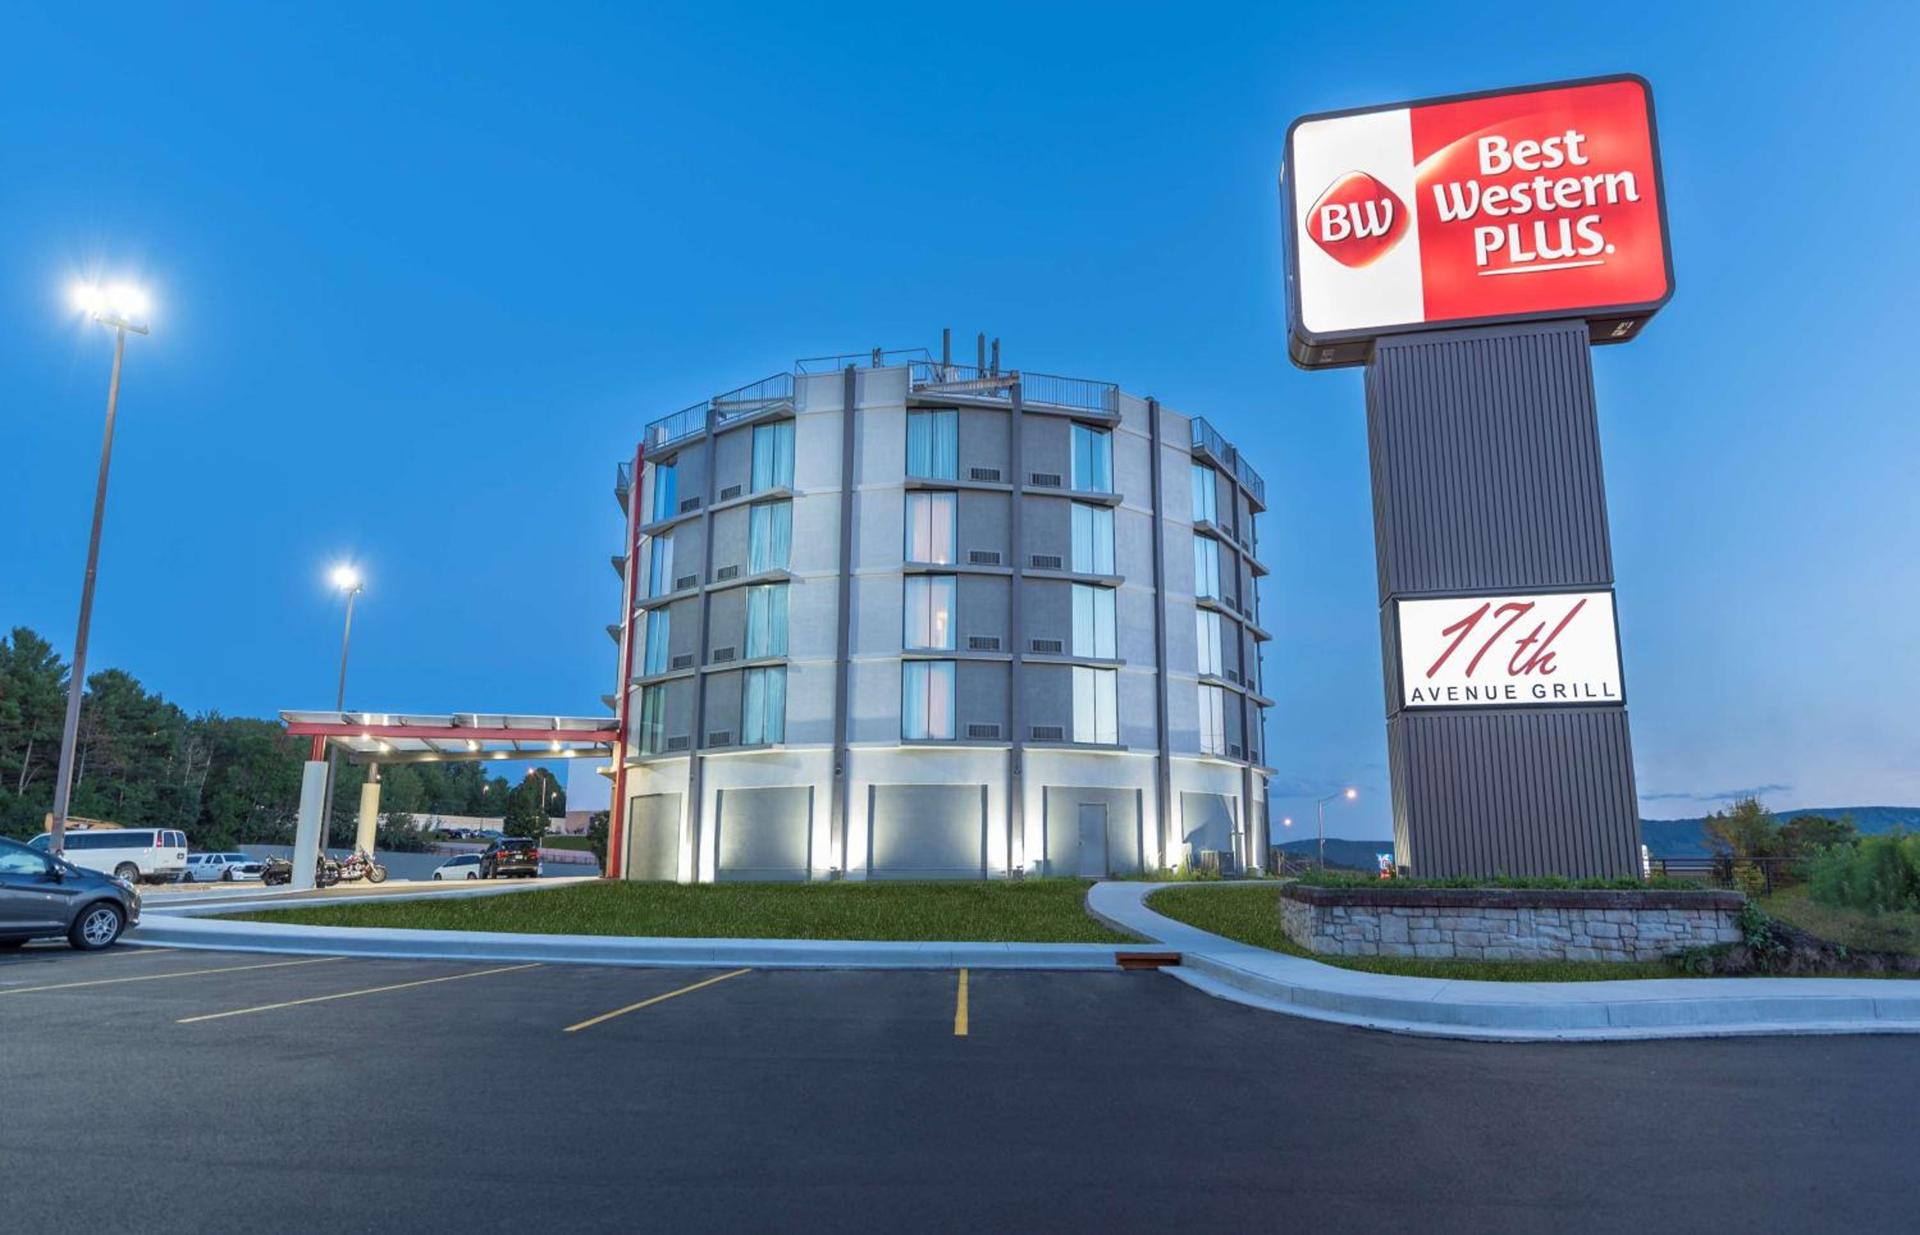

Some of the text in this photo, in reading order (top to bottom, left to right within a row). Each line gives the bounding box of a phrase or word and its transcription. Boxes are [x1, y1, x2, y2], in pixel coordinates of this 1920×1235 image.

[1477, 130, 1589, 176] Best
[1433, 170, 1640, 223] Western
[1319, 199, 1395, 242] BW
[1426, 598, 1588, 679] 17th
[1411, 682, 1615, 702] AVENUE GRILL
